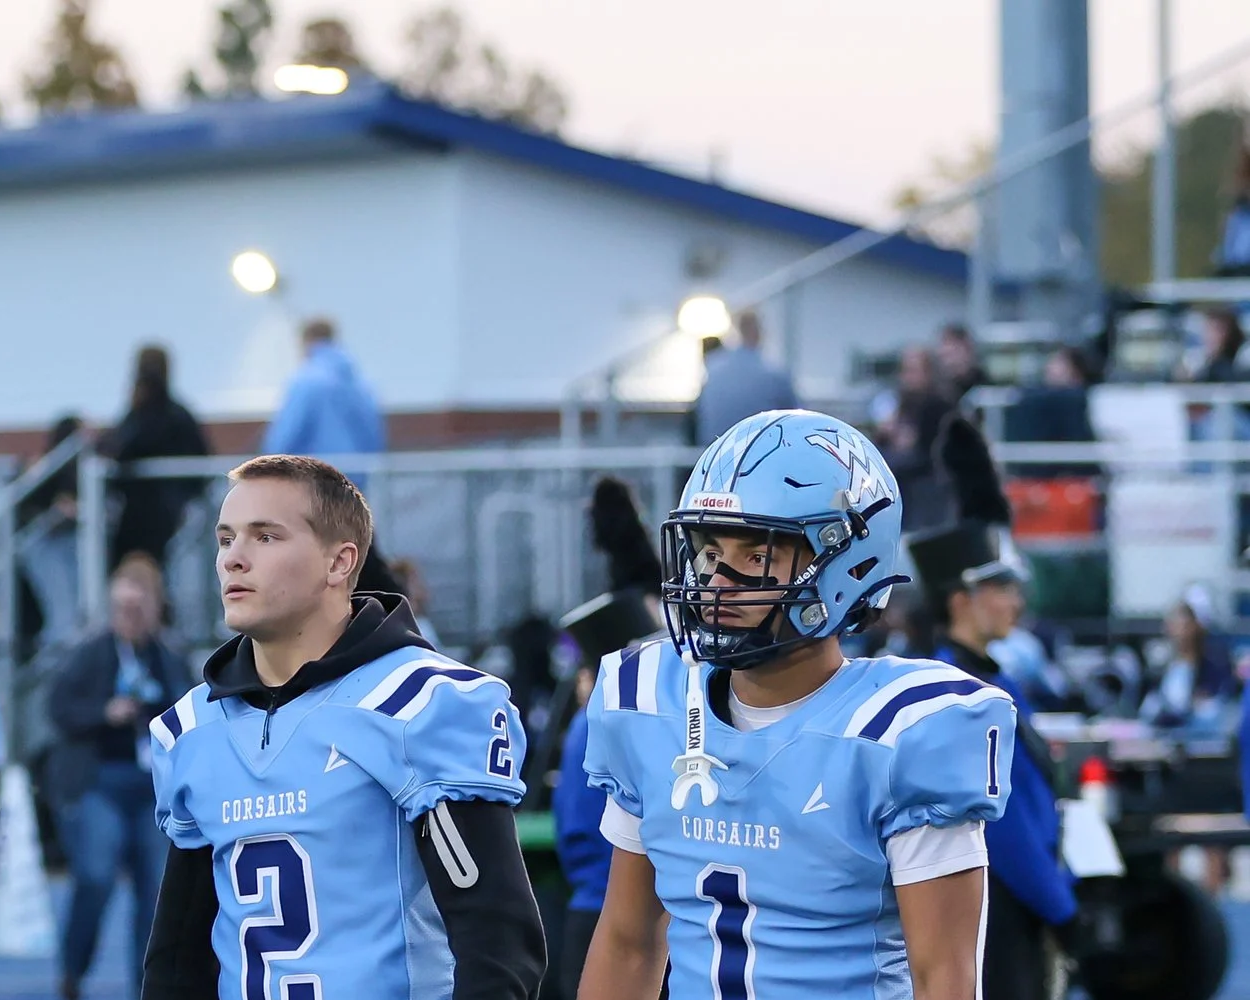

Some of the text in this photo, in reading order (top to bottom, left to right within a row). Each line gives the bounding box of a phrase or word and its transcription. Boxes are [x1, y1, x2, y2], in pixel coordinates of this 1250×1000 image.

[486, 707, 513, 780] 2
[688, 707, 701, 750] NXTRND
[986, 726, 1000, 798] 1
[221, 789, 308, 824] CORSAIRS
[681, 815, 781, 850] CORSAIRS
